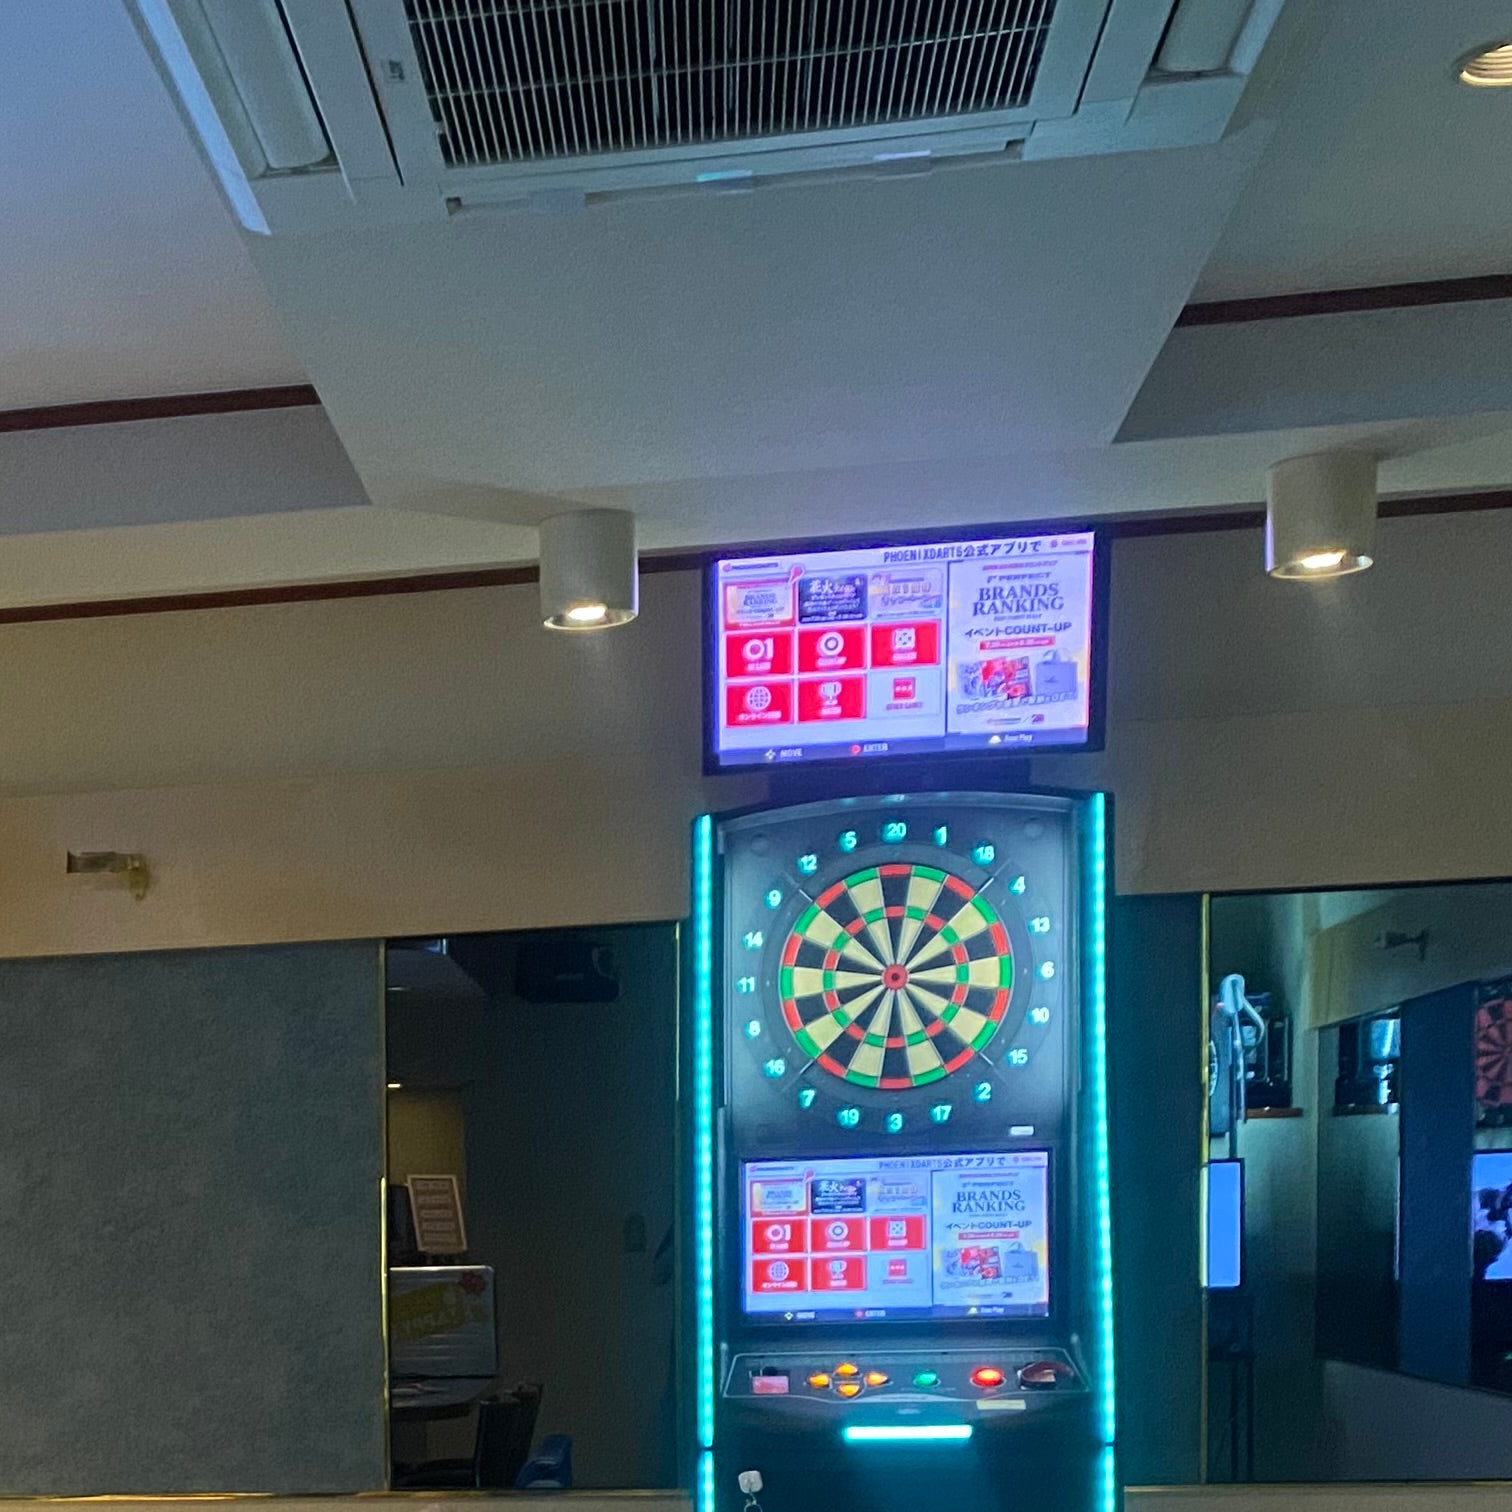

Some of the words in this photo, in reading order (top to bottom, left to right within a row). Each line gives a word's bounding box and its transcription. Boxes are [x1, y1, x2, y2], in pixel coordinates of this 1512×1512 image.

[979, 583, 1060, 602] BRANDS
[973, 597, 1065, 617] RANKING
[965, 622, 1072, 638] イベントCOUNT-UP
[887, 822, 907, 839] 20
[937, 827, 947, 843] 1
[844, 832, 857, 848] 5
[976, 845, 995, 861] 18
[800, 855, 817, 871] 12
[1012, 877, 1026, 893] 4
[768, 891, 781, 906] 9
[1032, 917, 1050, 932] 13
[745, 933, 763, 948] 14
[1041, 962, 1054, 978] 6
[738, 977, 756, 992] 11
[1032, 1007, 1050, 1023] 10
[1010, 1050, 1027, 1065] 15
[767, 1059, 785, 1075] 16
[801, 1090, 815, 1105] 7
[978, 1084, 991, 1100] 2
[841, 1109, 859, 1124] 19
[933, 1105, 952, 1121] 17
[890, 1114, 903, 1130] 3
[957, 1190, 1021, 1202] BRANDS
[952, 1200, 1026, 1213] RANKING
